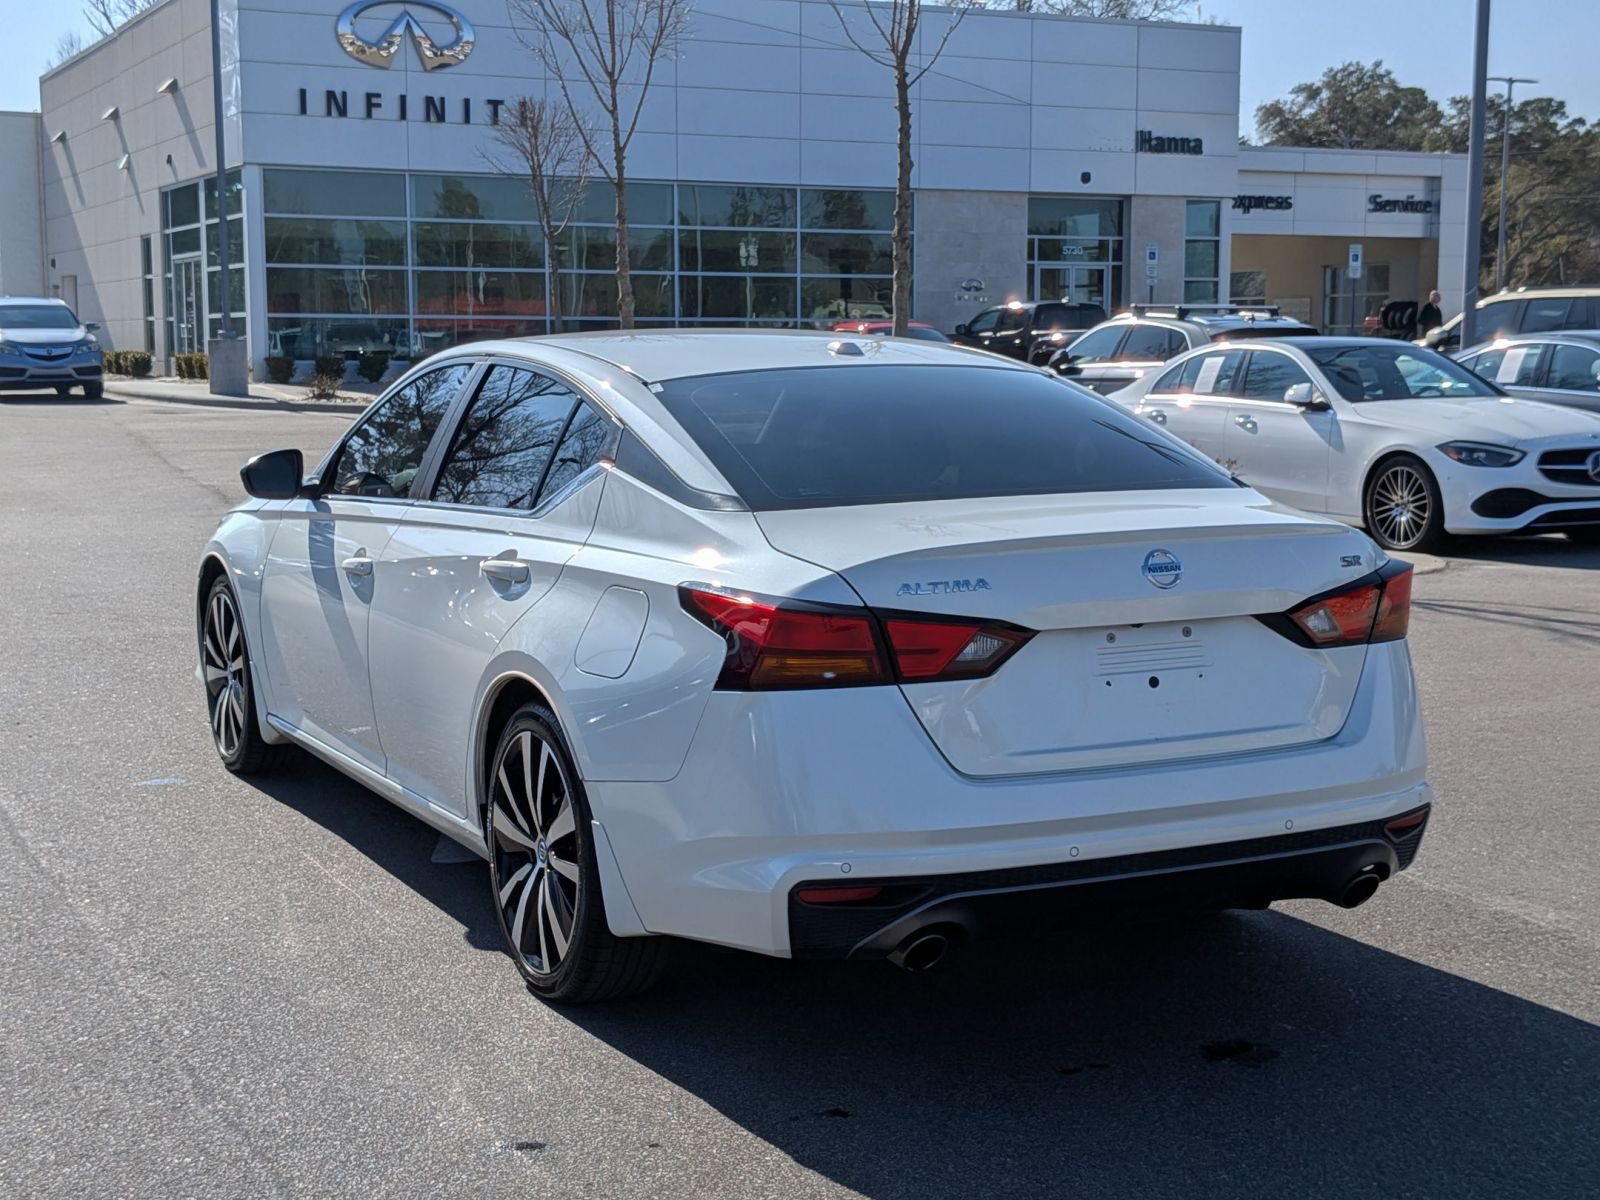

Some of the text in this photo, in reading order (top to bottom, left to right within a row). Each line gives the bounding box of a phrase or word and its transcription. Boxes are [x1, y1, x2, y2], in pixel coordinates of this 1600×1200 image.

[1136, 130, 1203, 155] Hanna
[1232, 195, 1293, 214] xpress
[1368, 194, 1433, 213] Service
[1148, 563, 1182, 574] NISSAN
[1340, 554, 1362, 568] SR
[896, 578, 992, 597] ALTIMA
